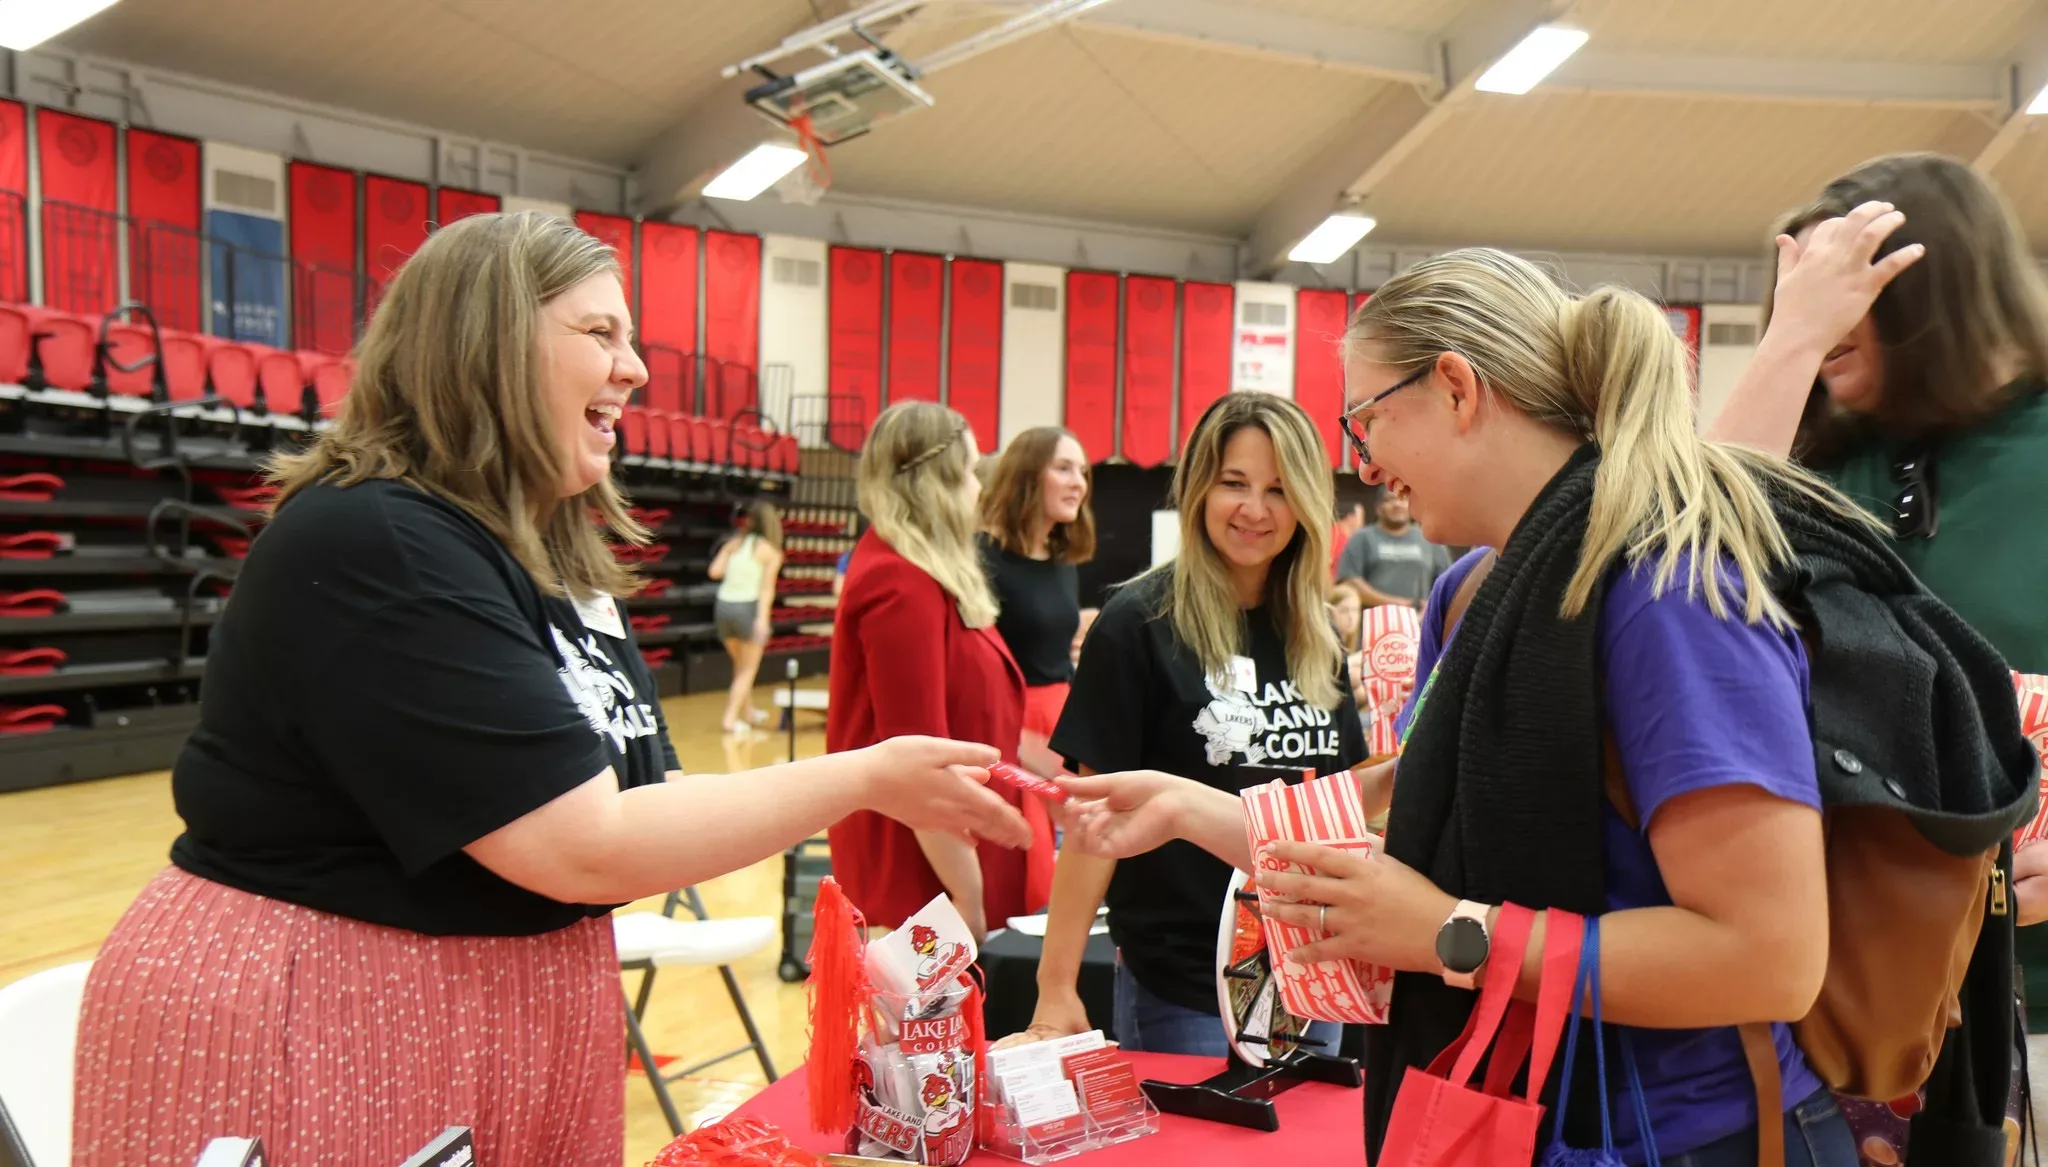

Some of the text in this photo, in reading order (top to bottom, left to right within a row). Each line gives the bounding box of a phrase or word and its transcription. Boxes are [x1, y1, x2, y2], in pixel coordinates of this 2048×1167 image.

[1383, 641, 1408, 653] POP
[1378, 653, 1414, 665] CORN
[1249, 680, 1304, 707] LAK
[1225, 714, 1253, 726] LAKERS
[1258, 704, 1331, 732] LAND
[1265, 730, 1339, 759] COLLE
[902, 1019, 947, 1040] LAKE
[882, 1106, 901, 1119] LAKE
[901, 1113, 922, 1126] LAND
[860, 1107, 919, 1151] KERS
